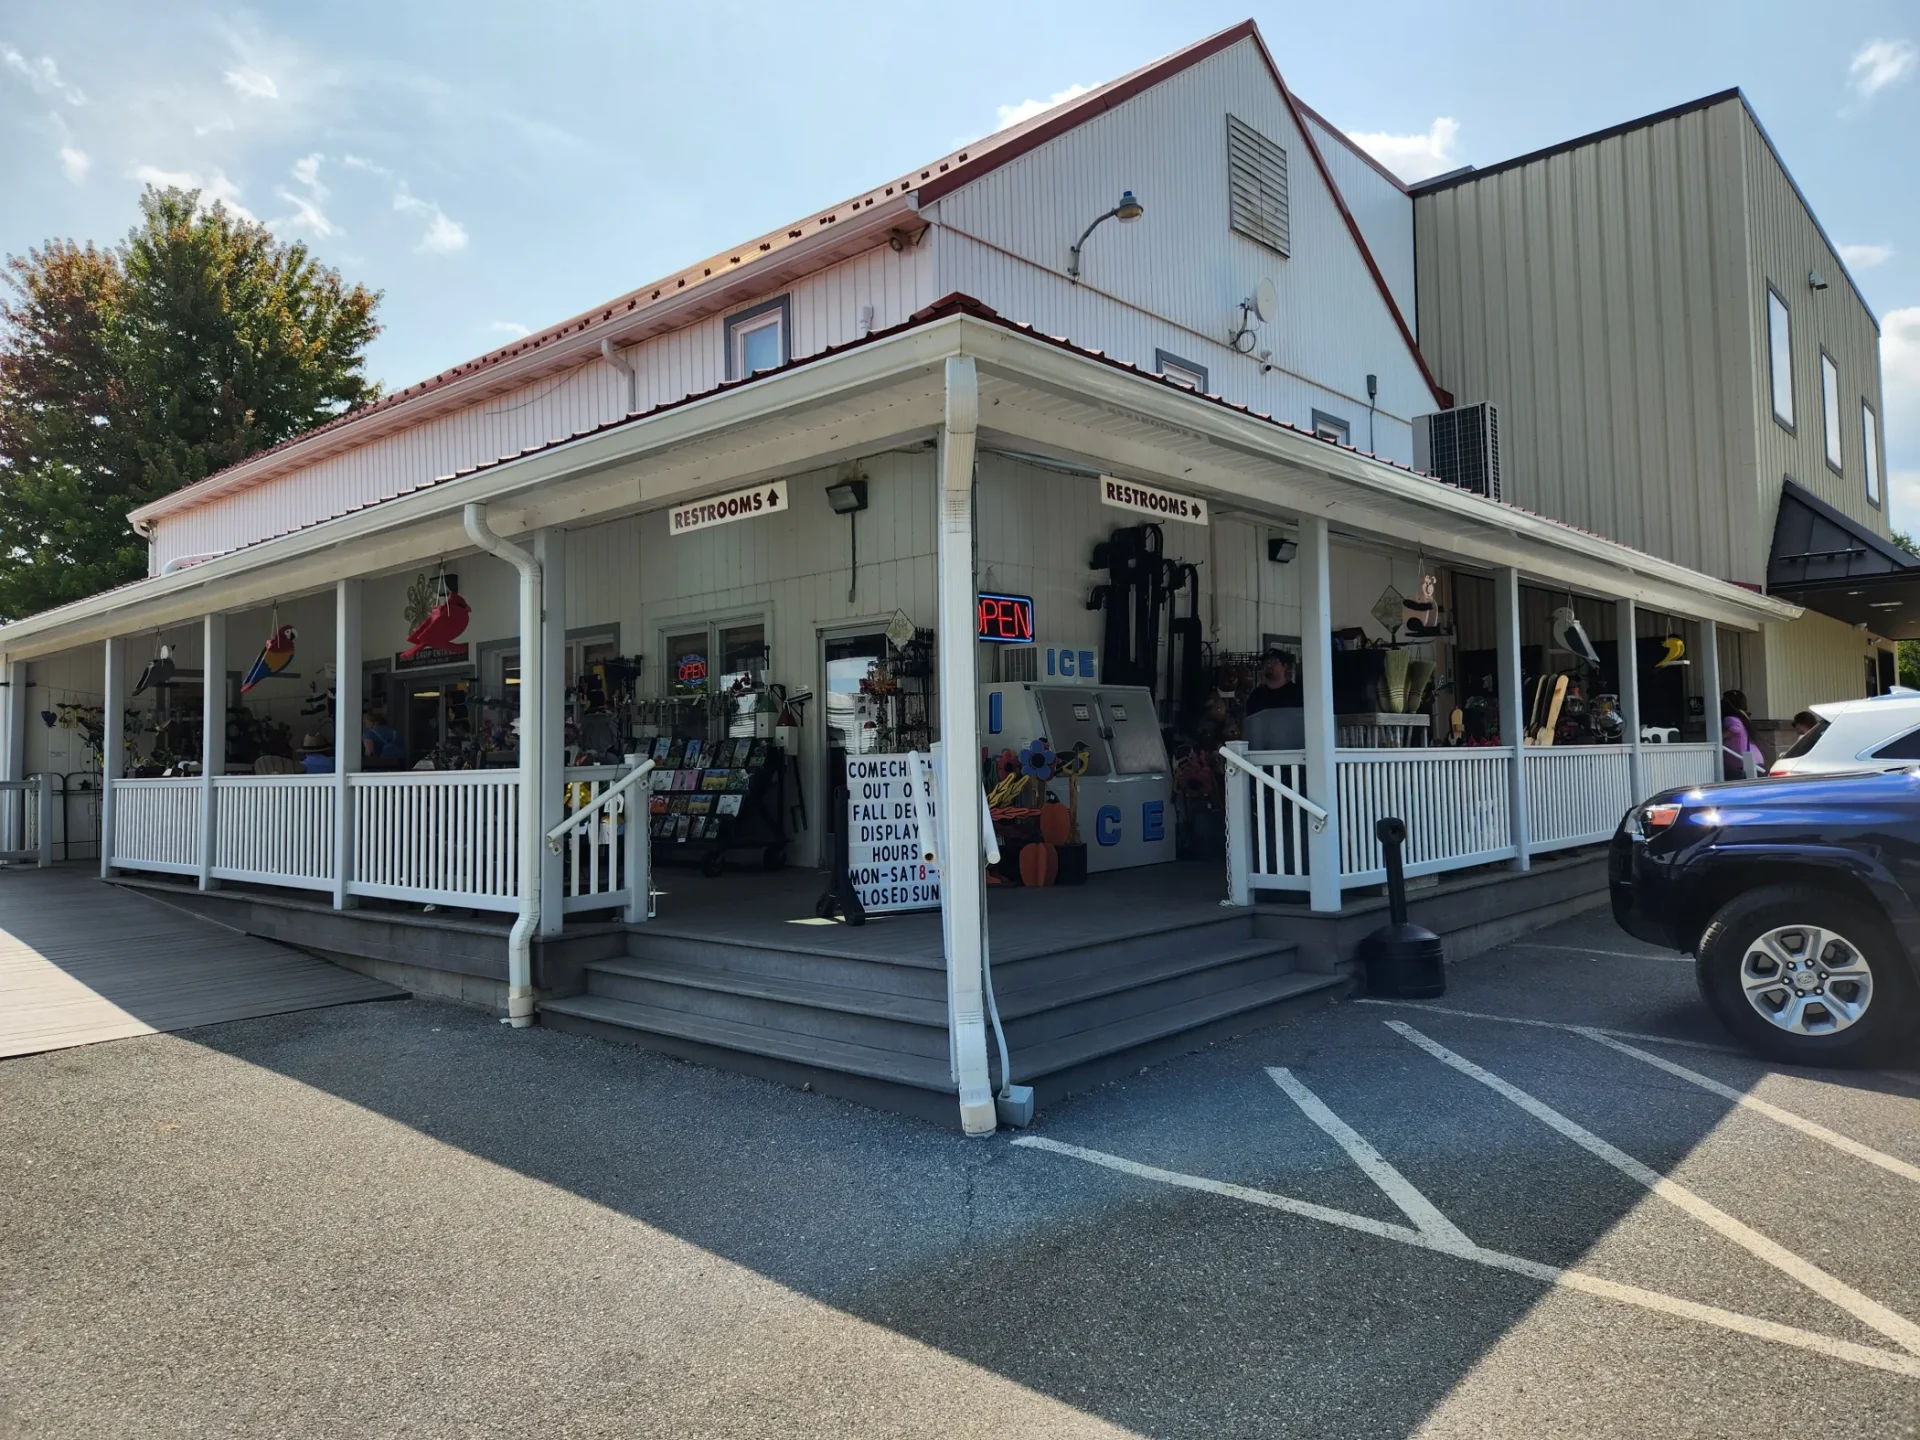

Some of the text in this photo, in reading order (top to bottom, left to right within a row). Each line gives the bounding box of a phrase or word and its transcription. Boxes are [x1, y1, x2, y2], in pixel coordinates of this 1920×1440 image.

[1106, 481, 1188, 517] RESTROOMS
[674, 492, 763, 529] RESTROOMS
[678, 660, 707, 681] OPEN
[1046, 648, 1095, 677] ICE
[863, 782, 931, 799] OUT OR
[853, 804, 887, 821] FALL
[861, 823, 919, 842] DISPLAY
[872, 844, 918, 862] HOURS
[912, 884, 939, 902] SUN
